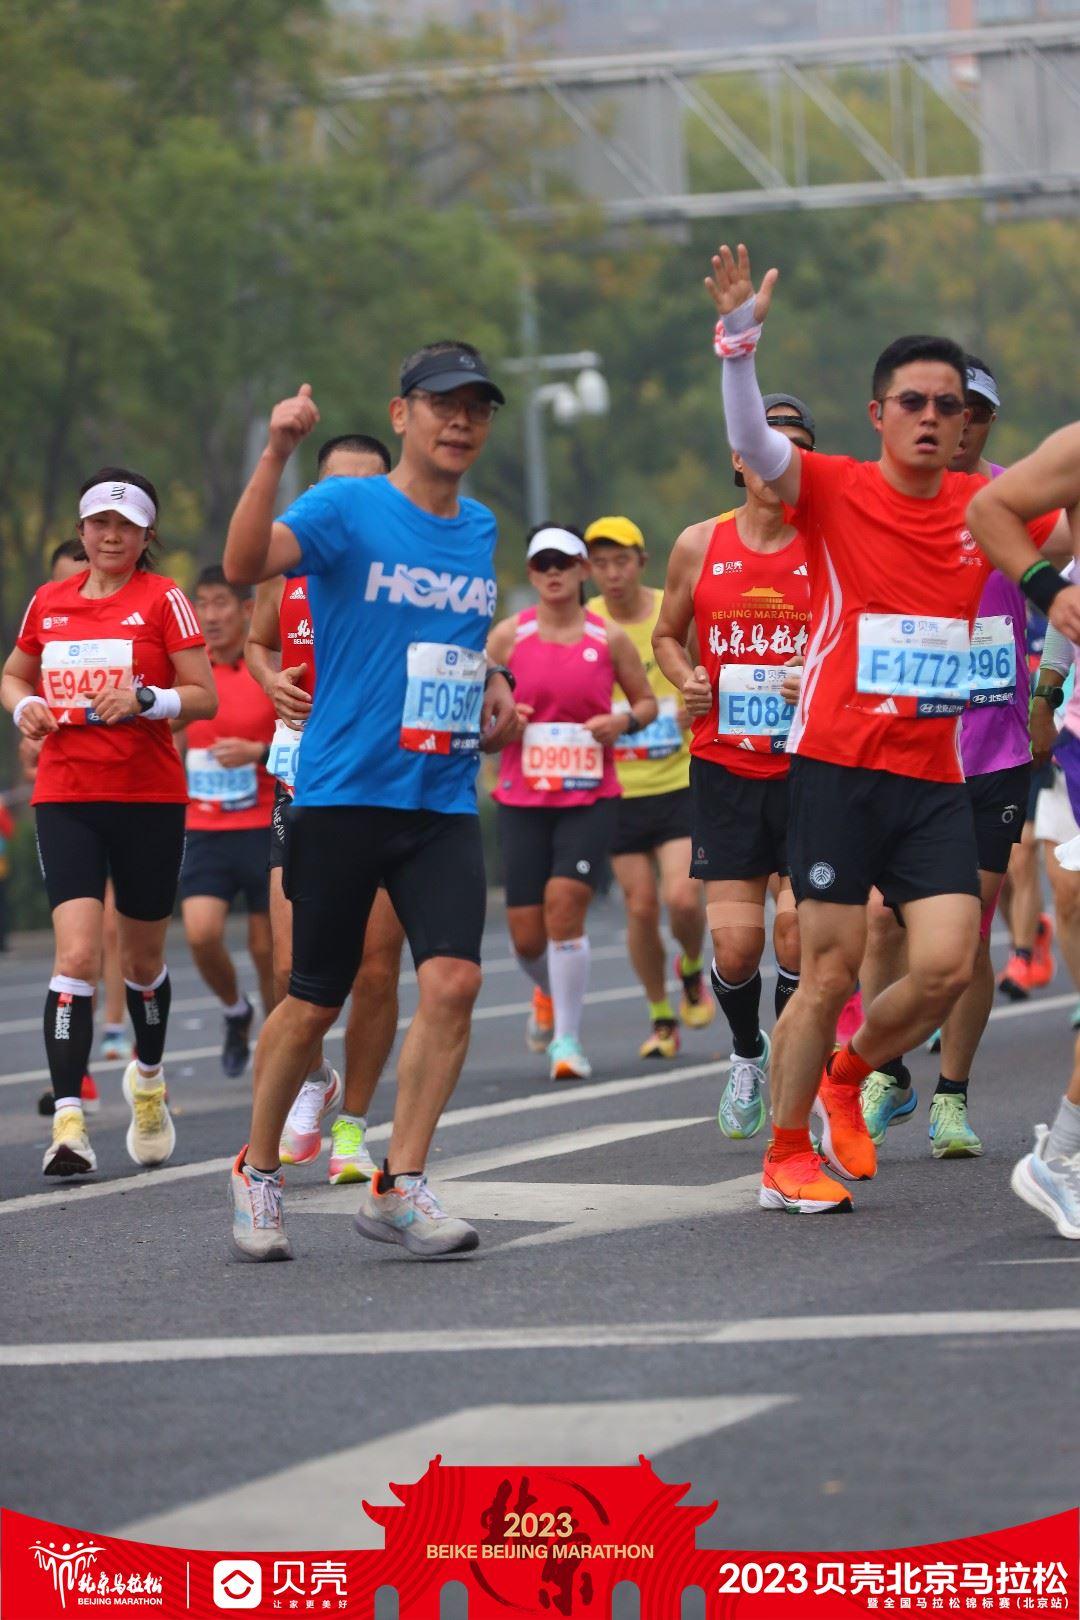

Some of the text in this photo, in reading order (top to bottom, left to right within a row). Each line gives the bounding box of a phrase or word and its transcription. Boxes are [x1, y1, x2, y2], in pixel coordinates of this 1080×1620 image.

[364, 561, 487, 616] HOKA
[712, 610, 810, 621] BEIJING MARATHO
[870, 648, 961, 688] F1772
[48, 669, 124, 700] E9427
[529, 746, 597, 771] D9015
